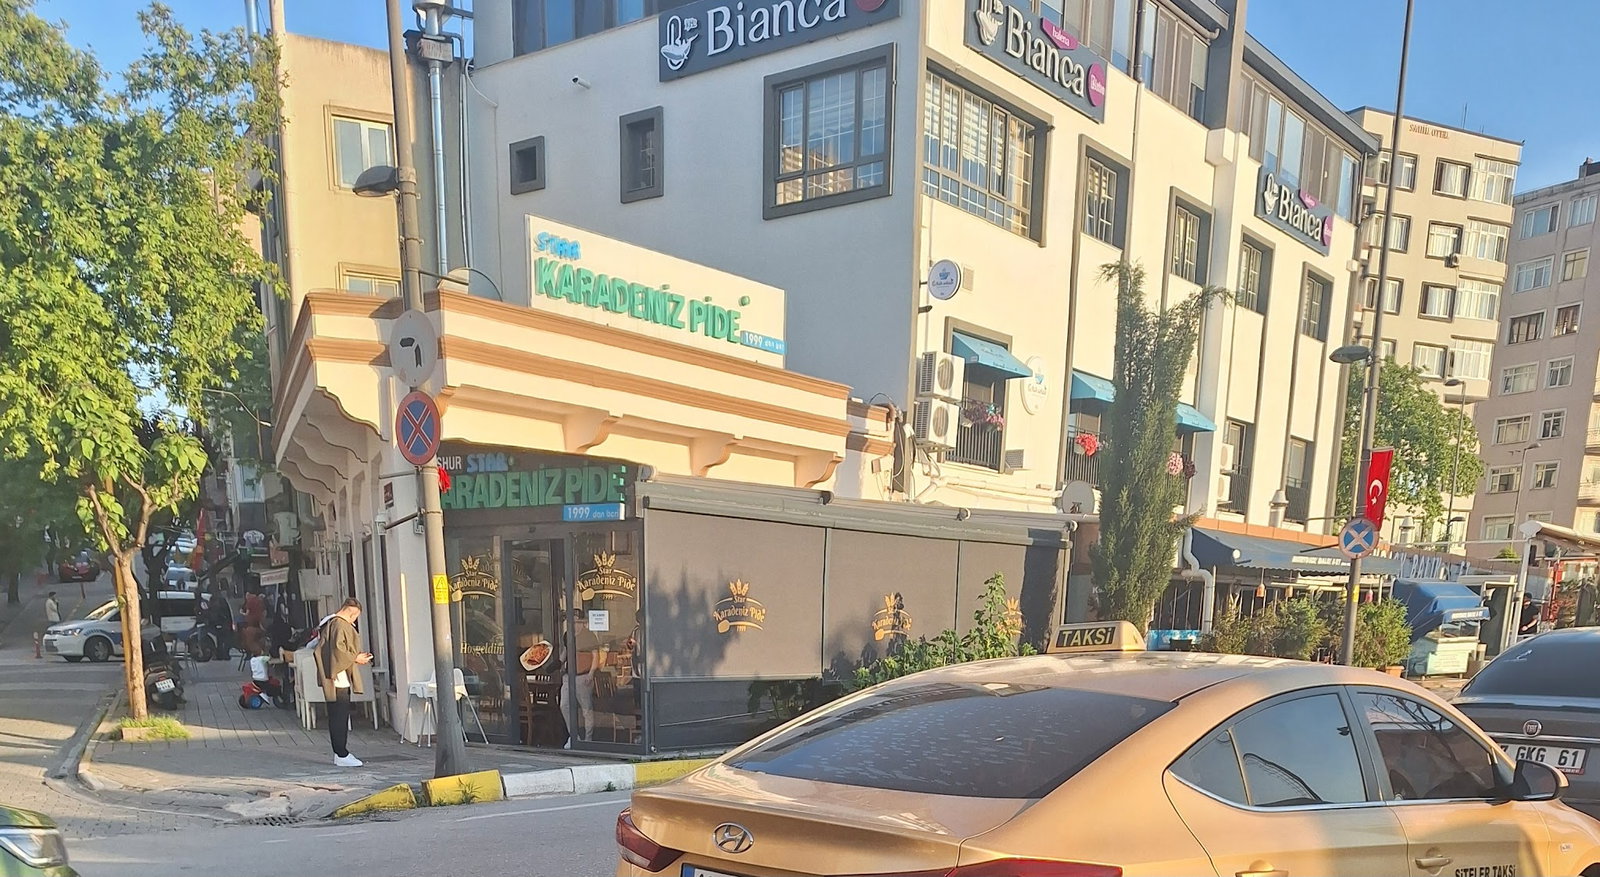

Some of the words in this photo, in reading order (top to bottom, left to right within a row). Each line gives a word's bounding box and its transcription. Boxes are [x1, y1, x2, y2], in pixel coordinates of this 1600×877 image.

[706, 0, 847, 56] Bianca
[1006, 5, 1085, 97] Bianca
[1278, 185, 1322, 241] Bianca
[534, 257, 686, 329] KARADENİZ
[689, 295, 742, 343] PİDE
[744, 332, 763, 347] 1999
[440, 464, 563, 510] ARADENİZ
[564, 461, 627, 504] PİDE
[567, 506, 590, 520] 1999
[599, 566, 613, 575] Star
[576, 574, 616, 591] Karadeniz
[617, 576, 636, 591] Pide
[713, 605, 749, 621] Karadeniz
[1515, 746, 1547, 763] GKG
[1557, 749, 1580, 767] 61
